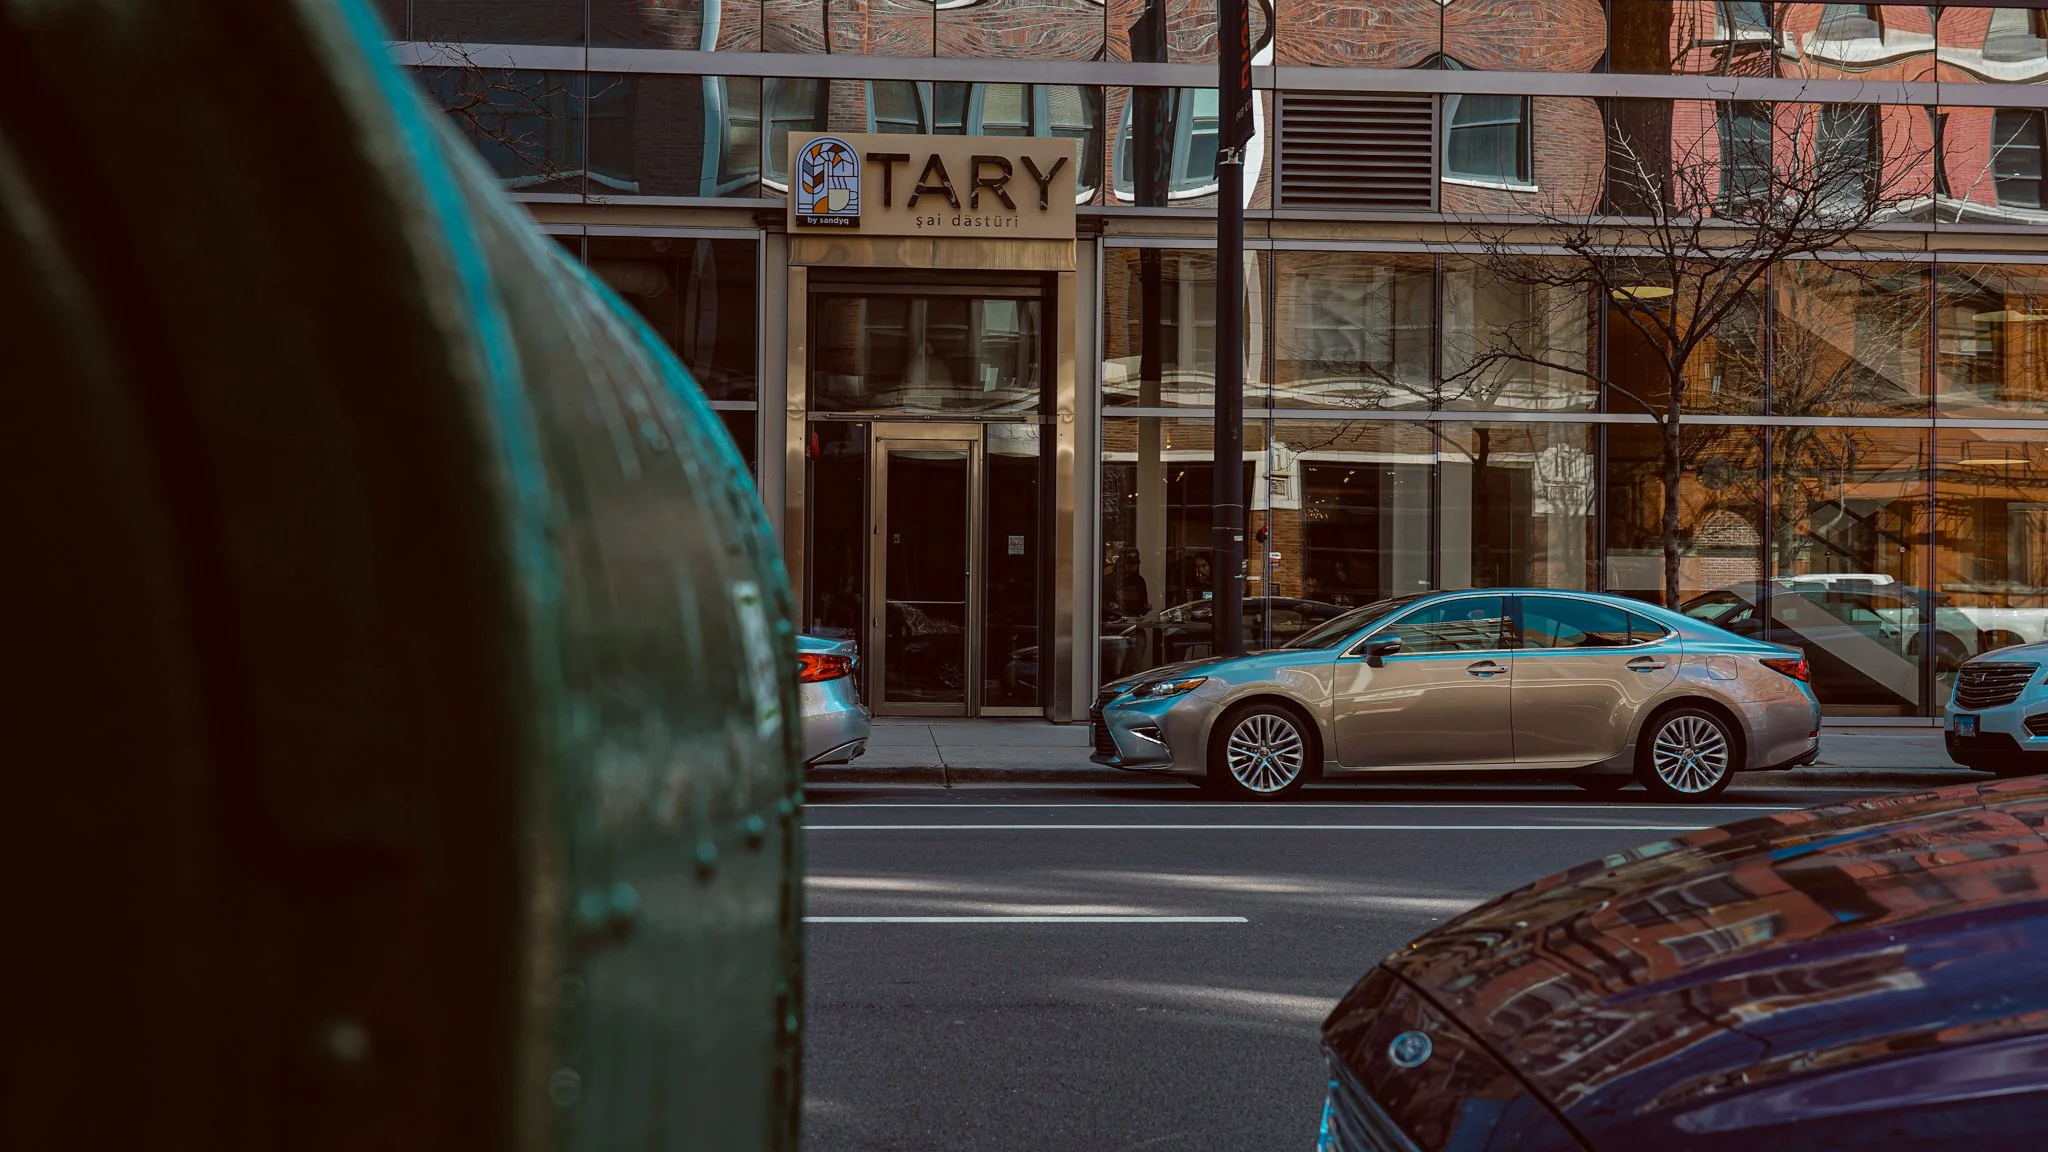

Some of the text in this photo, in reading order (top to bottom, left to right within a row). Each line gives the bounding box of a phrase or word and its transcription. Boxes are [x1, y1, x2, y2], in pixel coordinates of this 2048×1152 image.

[866, 152, 1069, 211] TARY
[807, 216, 849, 225] by sandyq
[915, 213, 1018, 229] şai dästüri
